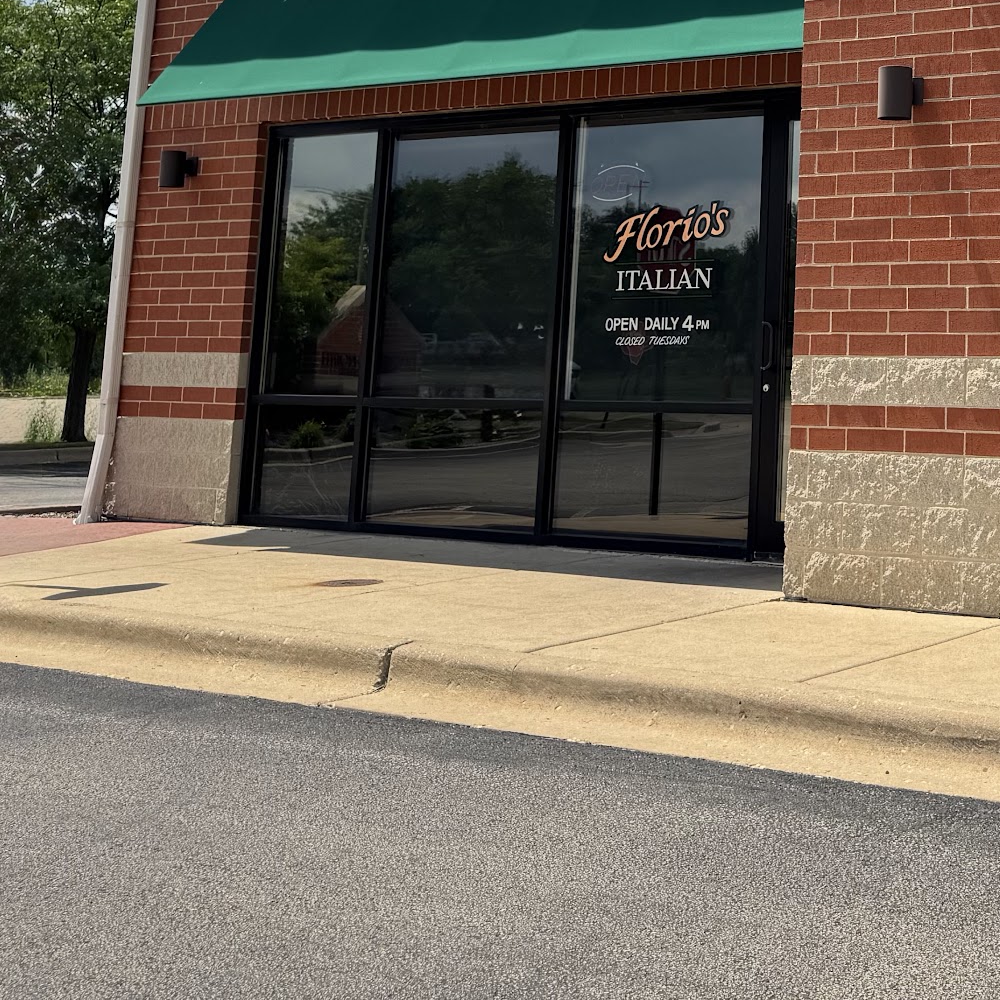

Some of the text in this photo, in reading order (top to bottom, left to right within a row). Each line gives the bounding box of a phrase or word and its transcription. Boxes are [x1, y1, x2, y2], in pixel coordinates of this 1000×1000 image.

[603, 202, 730, 263] Florio's
[615, 267, 713, 292] ITALIAN
[605, 314, 710, 332] OPEN DAILY 4 PM
[615, 335, 691, 347] CLOSED TUESDAYS
